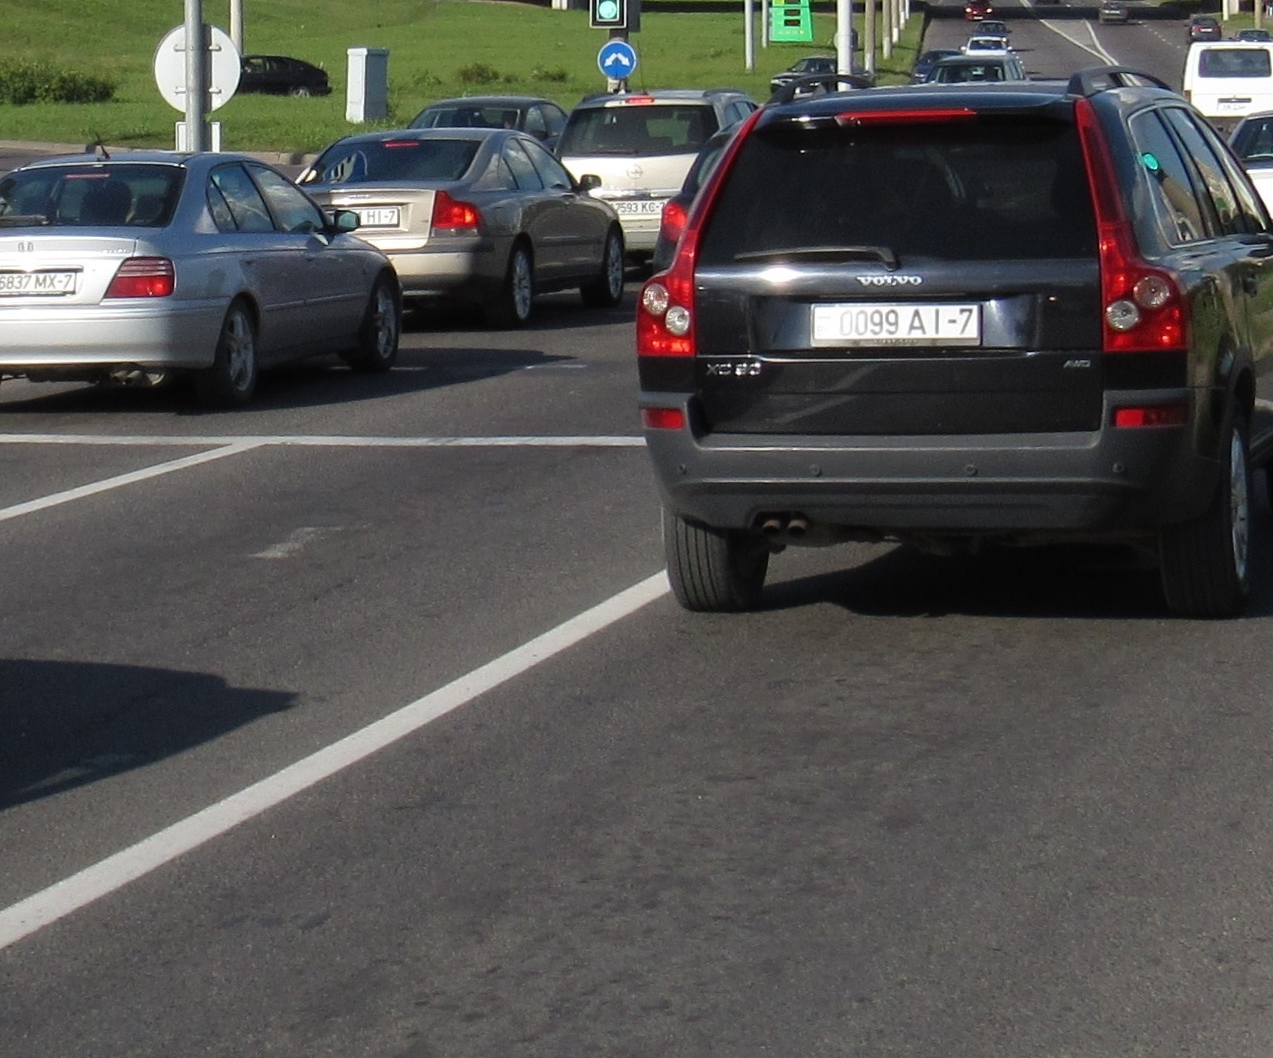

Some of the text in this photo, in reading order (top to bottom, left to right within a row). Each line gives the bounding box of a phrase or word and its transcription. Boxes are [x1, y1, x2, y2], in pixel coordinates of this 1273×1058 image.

[34, 274, 73, 290] MX-7
[856, 275, 923, 286] VOLVO
[840, 308, 974, 336] 0099 AI-7
